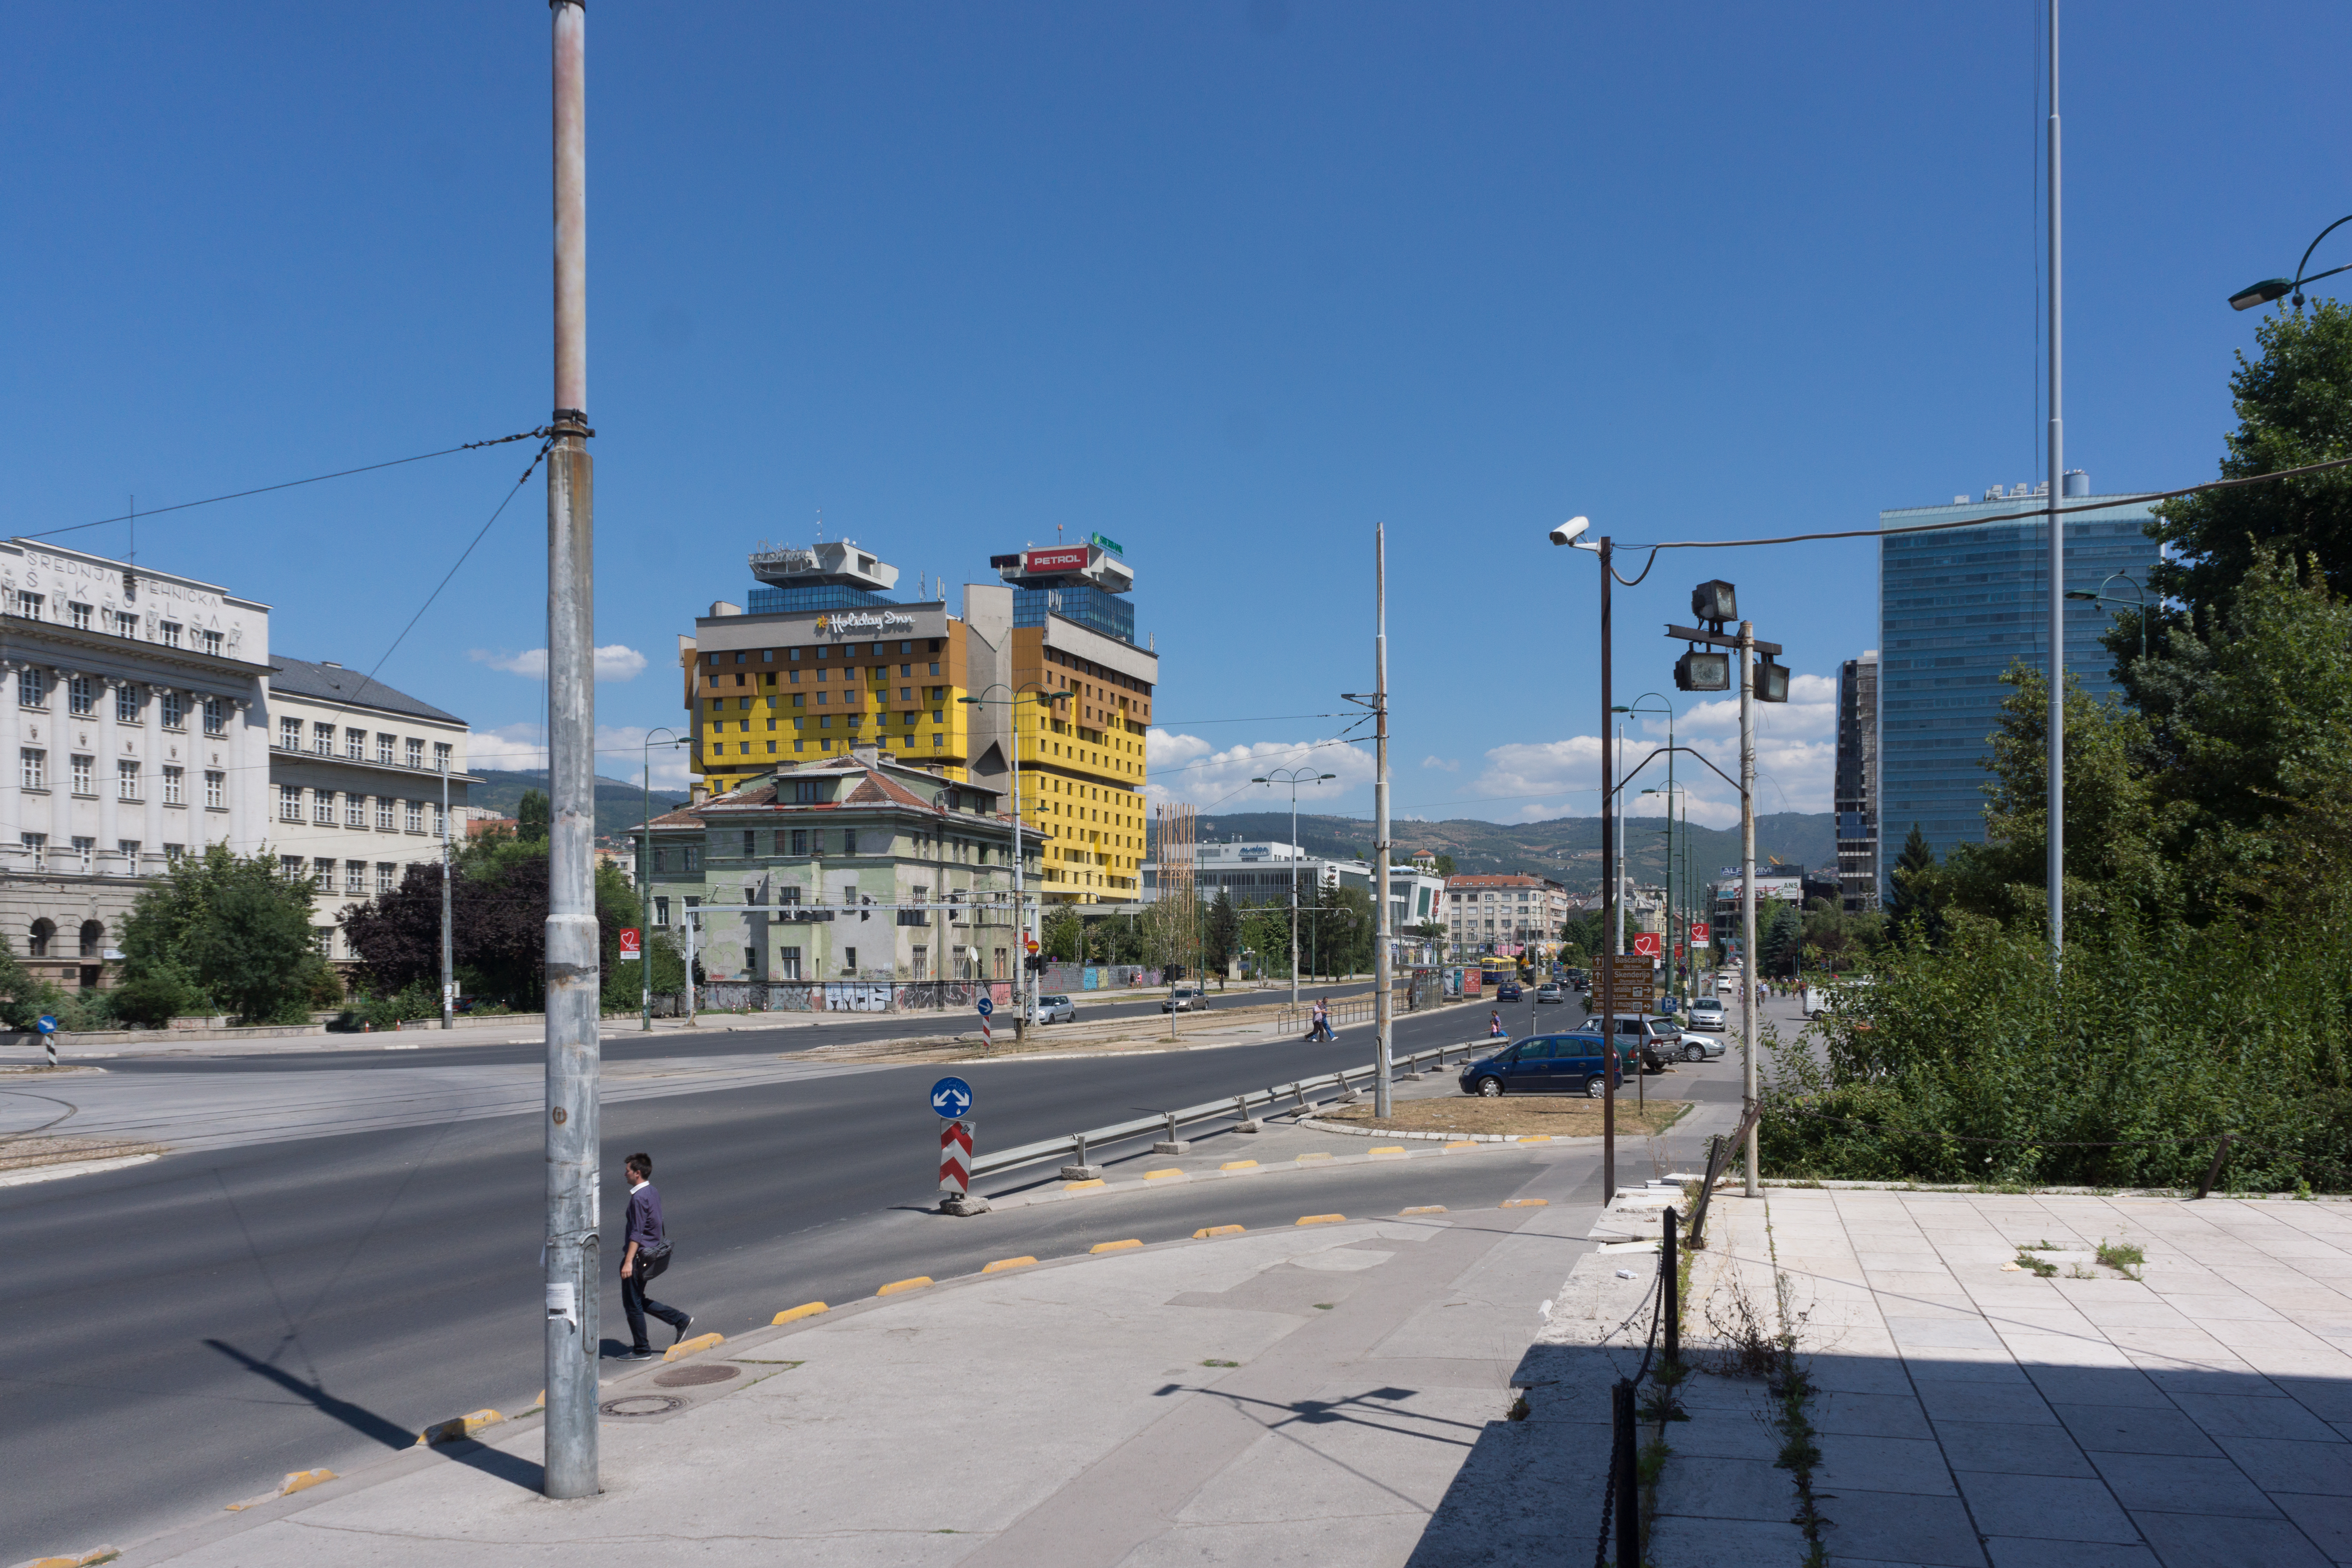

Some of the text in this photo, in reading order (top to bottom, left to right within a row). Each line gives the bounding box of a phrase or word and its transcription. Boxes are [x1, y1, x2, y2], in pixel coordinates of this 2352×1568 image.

[1100, 535, 1123, 554] SBERBANK
[1034, 555, 1081, 565] PETROL
[27, 552, 218, 608] SREDNJA TEHNIČKA
[26, 568, 220, 628] ŠKOLA
[830, 611, 916, 633] Holiday Inn
[1615, 956, 1649, 964] Baščaršija
[1618, 1000, 1632, 1009] muzej
